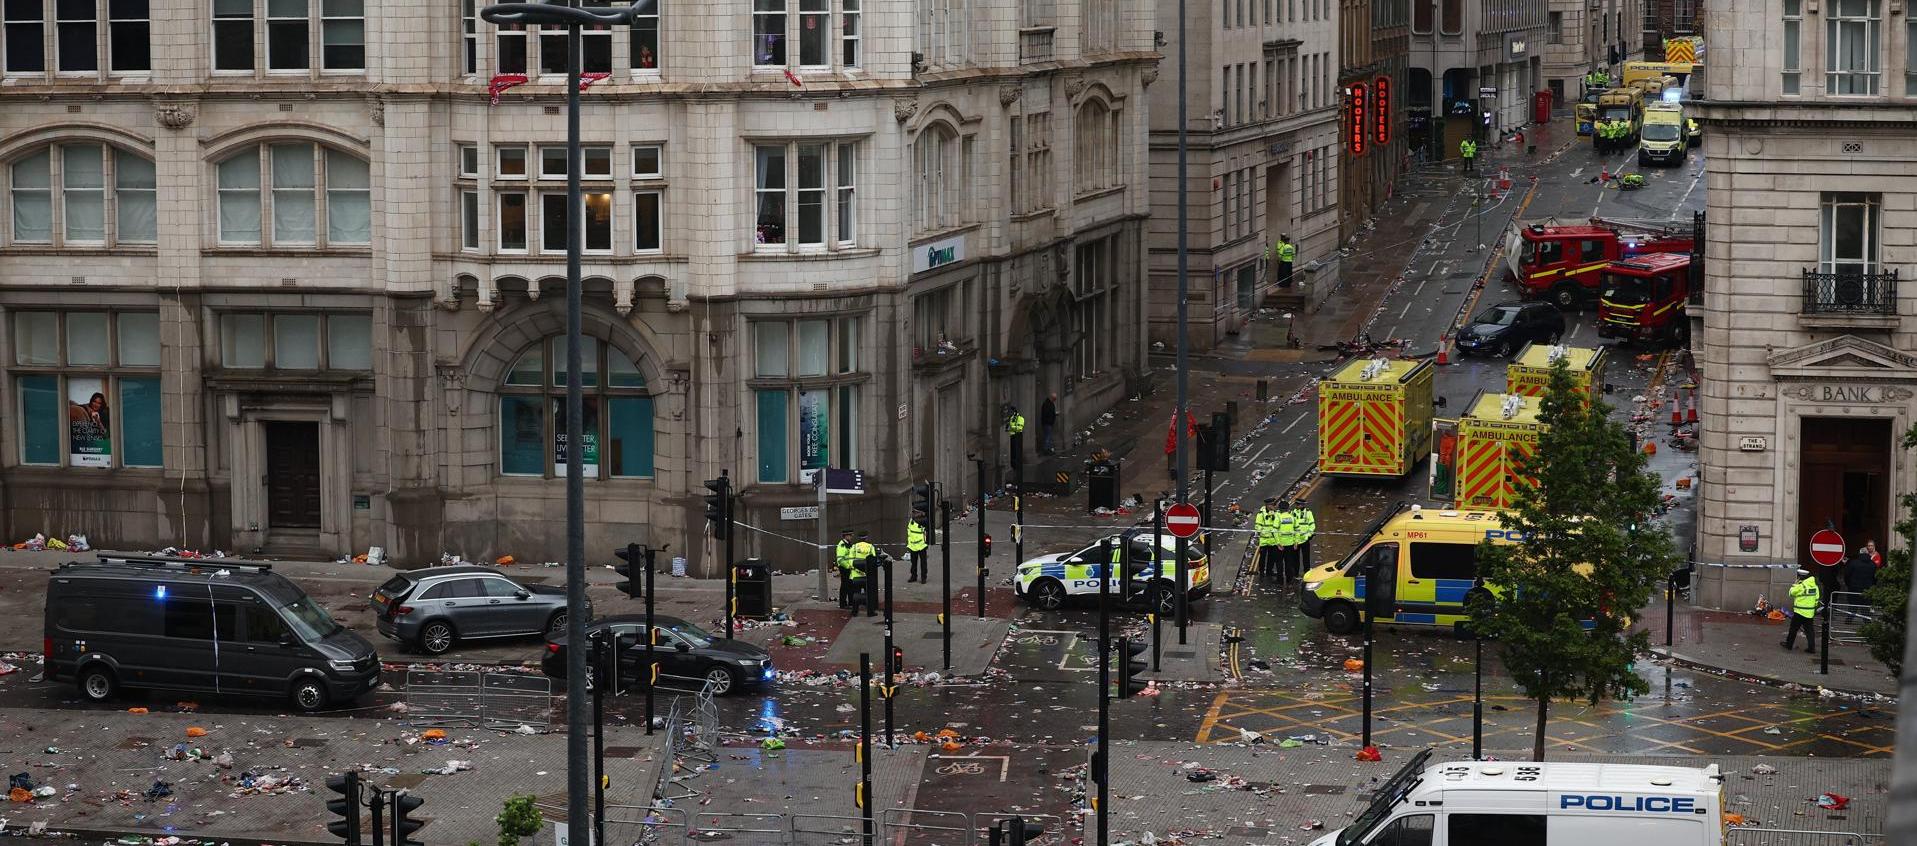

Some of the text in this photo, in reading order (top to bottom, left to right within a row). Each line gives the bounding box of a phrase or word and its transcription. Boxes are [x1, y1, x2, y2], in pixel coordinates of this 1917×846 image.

[1378, 82, 1386, 142] HOOTERS
[1354, 88, 1362, 152] HOOTERS
[1520, 376, 1552, 385] AMBUL
[1331, 393, 1393, 402] AMBULANCE
[1823, 386, 1873, 401] BANK
[1472, 430, 1537, 442] AMBULANCE
[1407, 531, 1428, 539] MP61
[1560, 794, 1695, 813] POLICE
